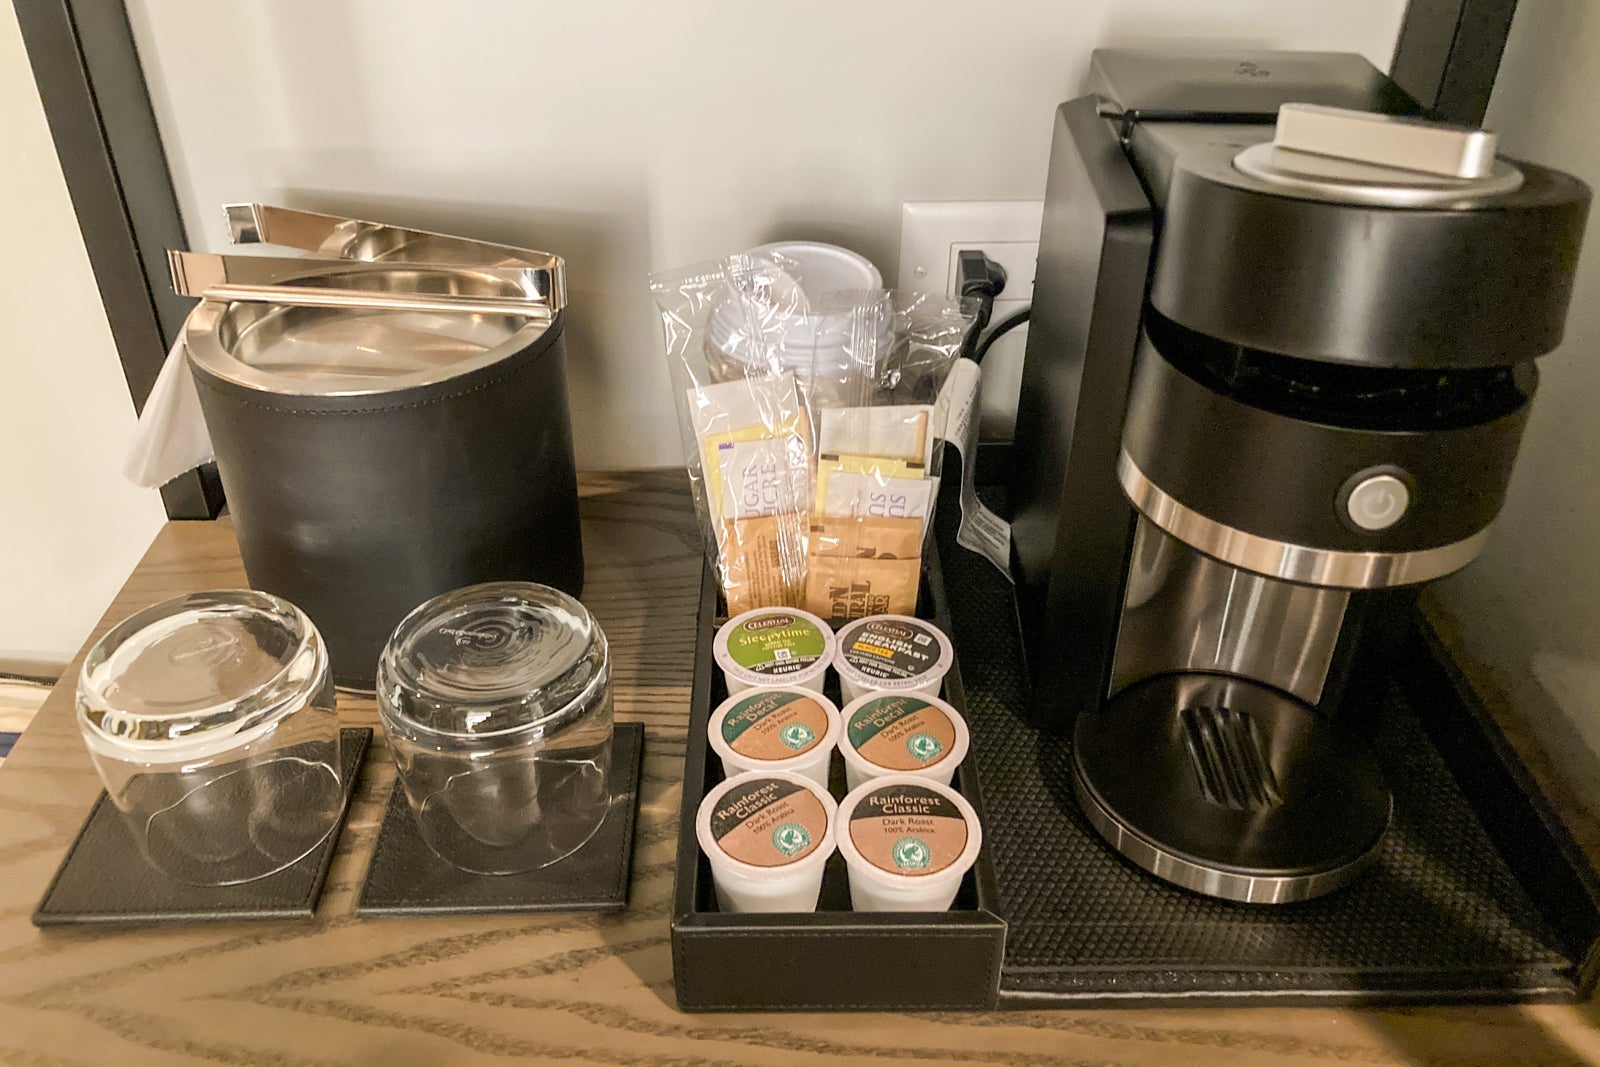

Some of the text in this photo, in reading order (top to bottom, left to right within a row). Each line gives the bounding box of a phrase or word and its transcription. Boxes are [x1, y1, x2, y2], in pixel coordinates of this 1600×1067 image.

[748, 618, 789, 629] CELESTIAL
[739, 629, 810, 646] Sleepytime
[861, 632, 913, 650] ENGLISH
[858, 637, 929, 661] BREAKFAST
[773, 664, 801, 674] KEURIG
[861, 665, 889, 678] KEURIG
[727, 693, 781, 727] Rainforest
[855, 699, 907, 730] Rainforest
[718, 782, 779, 820] Rainforest
[736, 793, 777, 819] Classic
[869, 795, 941, 806] Rainforest
[882, 803, 931, 814] Classic
[745, 802, 789, 829] Dark Roast
[882, 818, 934, 826] Dark Roast
